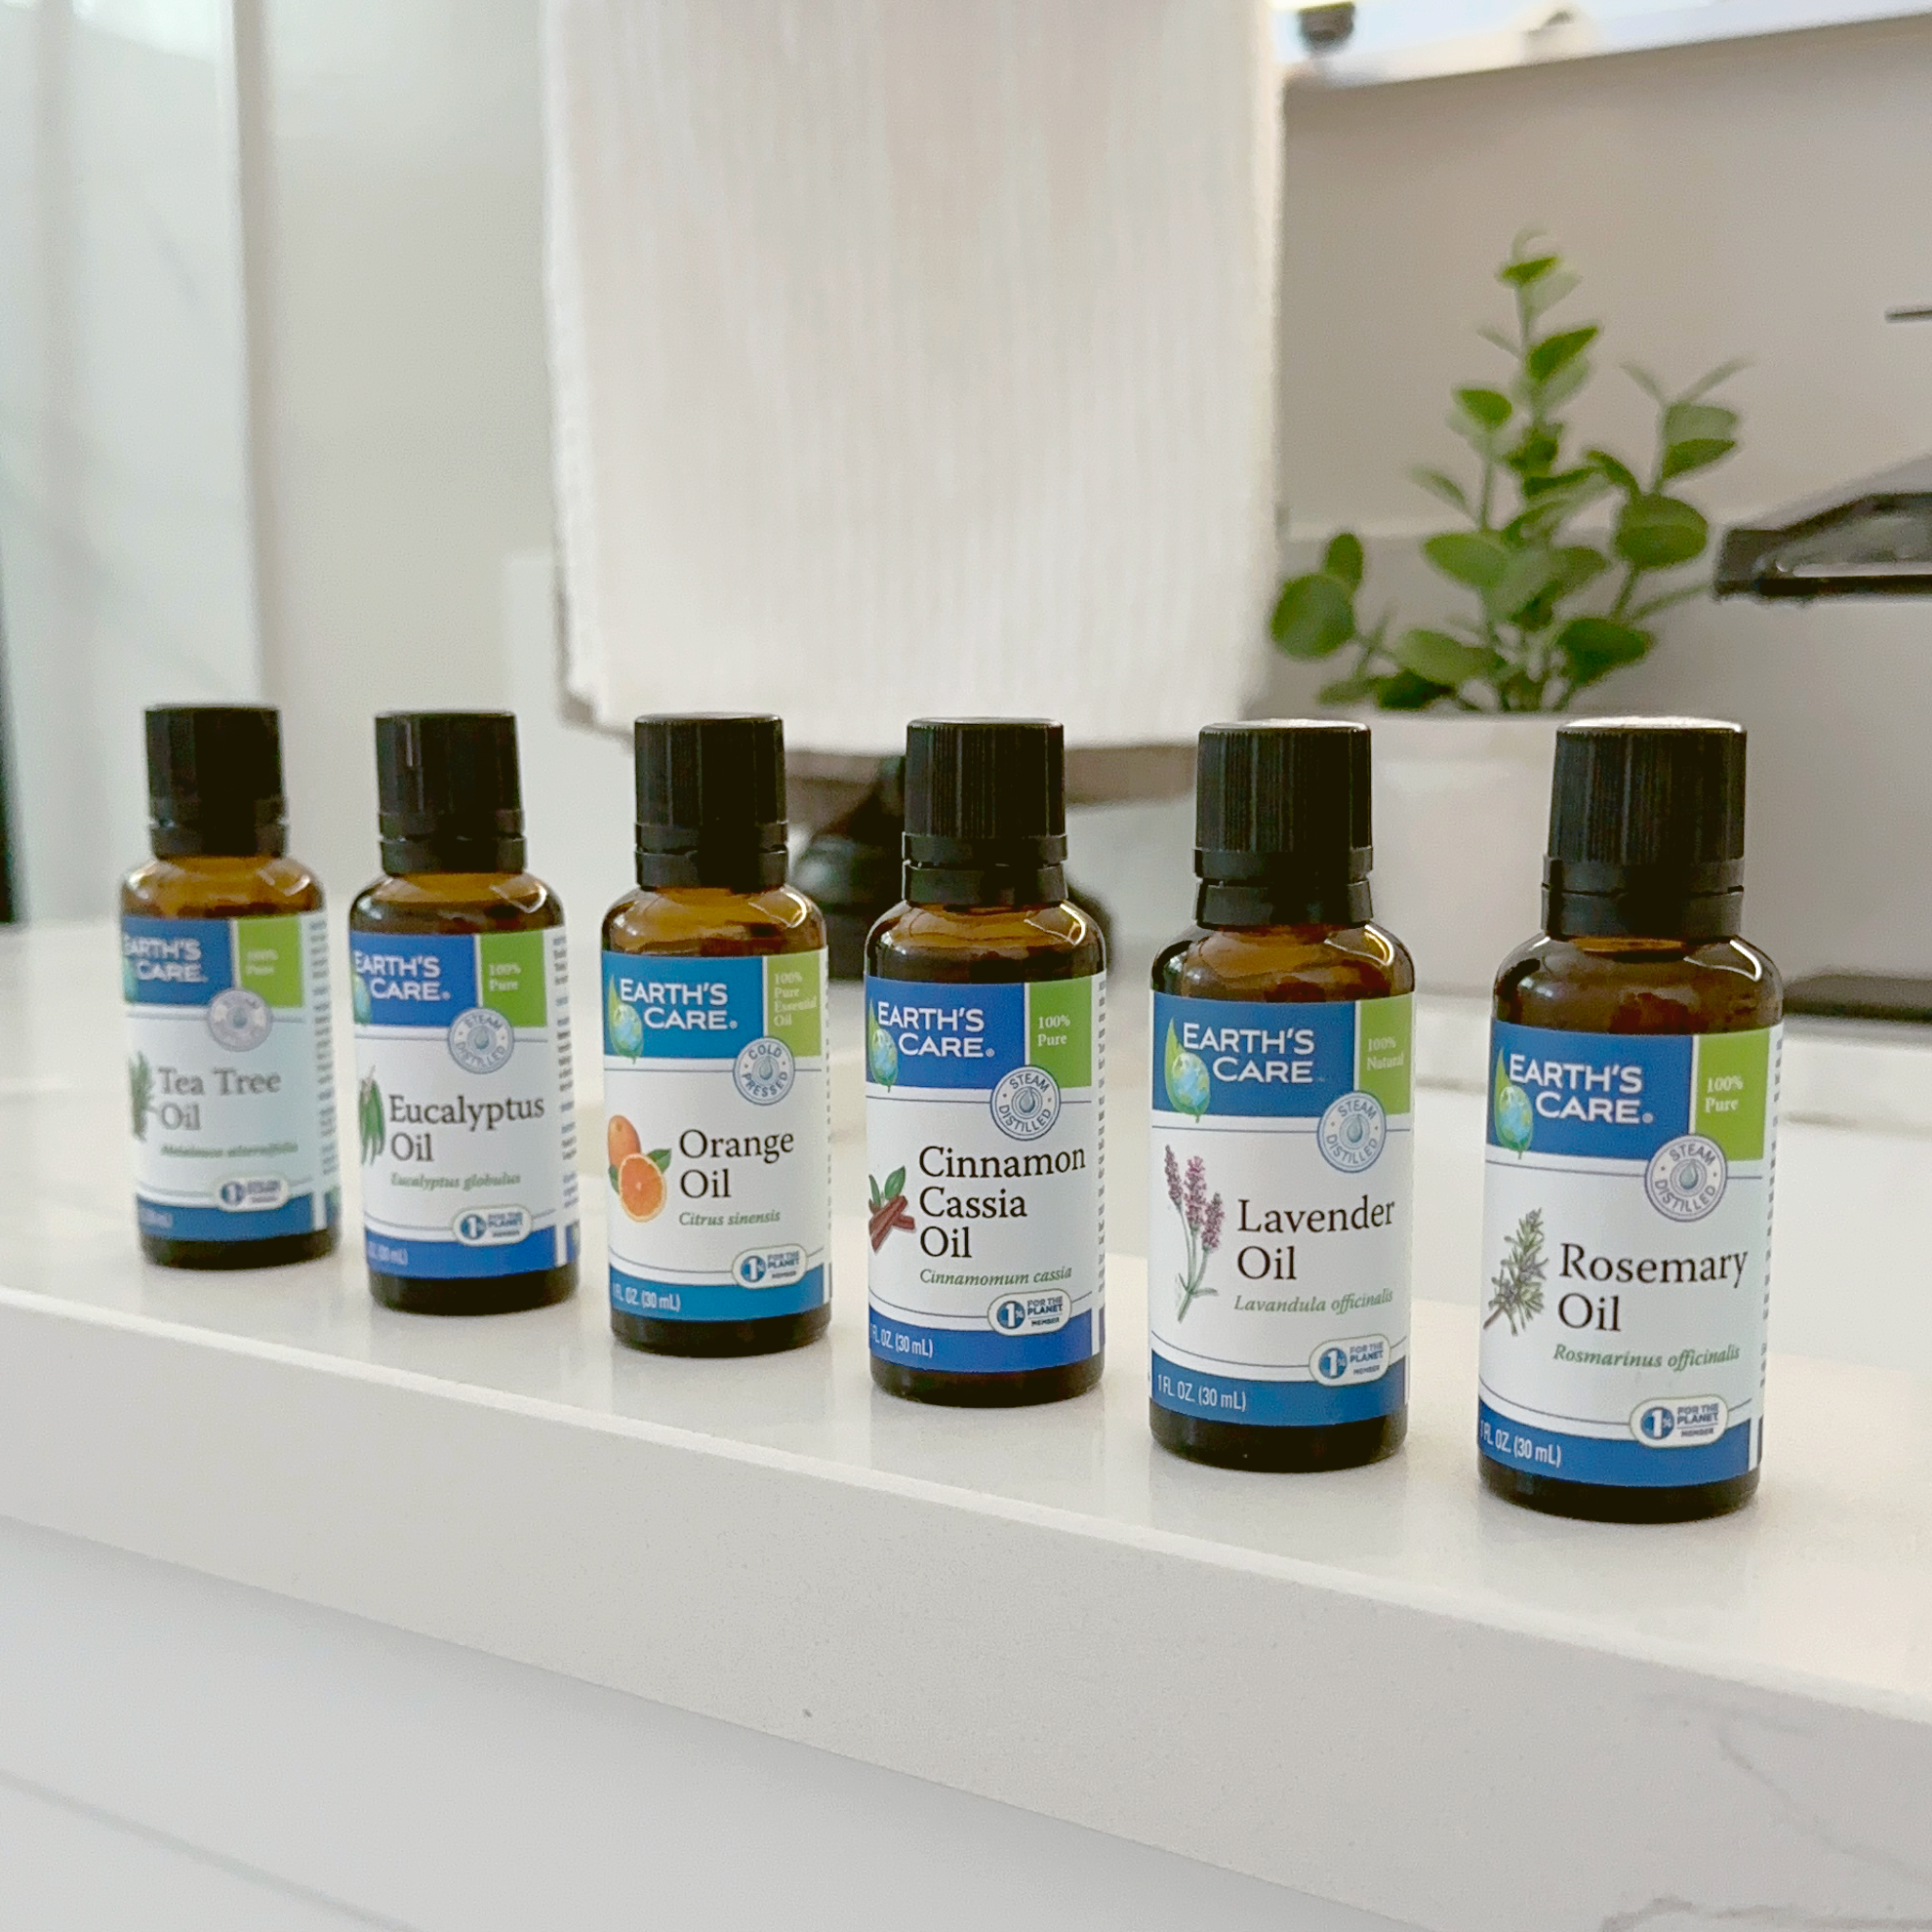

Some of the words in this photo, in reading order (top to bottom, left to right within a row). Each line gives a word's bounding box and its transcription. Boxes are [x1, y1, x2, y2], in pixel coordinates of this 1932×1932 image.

[620, 978, 728, 1006] EARTH'S
[878, 1001, 985, 1032] EARTH'S
[1038, 1015, 1070, 1029] 100%
[748, 1044, 782, 1060] COLD
[1037, 1034, 1067, 1047] Pure
[1183, 1023, 1314, 1055] EARTH'S
[1213, 1056, 1313, 1083] CARE
[1367, 1052, 1404, 1070] Natural
[1509, 1054, 1642, 1094] EARTH'S
[158, 1067, 205, 1096] Tea
[212, 1067, 281, 1096] Tree
[742, 1070, 787, 1098] PRESSED
[1010, 1072, 1050, 1093] STEAM
[1707, 1075, 1744, 1093] 100%
[161, 1103, 201, 1130] Oil
[388, 1095, 544, 1132] Eucalyptus
[999, 1105, 1051, 1133] DISTILLED
[1338, 1101, 1376, 1120] STEAM
[1705, 1098, 1739, 1113] Pure
[391, 1132, 434, 1161] Oil
[679, 1129, 794, 1164] Orange
[1326, 1134, 1378, 1163] DISTILLED
[1669, 1144, 1716, 1166] STEAM
[919, 1146, 1086, 1178] Cinnamon
[680, 1169, 731, 1199] Oil
[1655, 1179, 1716, 1212] DISTILLED
[919, 1187, 1027, 1218] Cassia
[1237, 1194, 1395, 1233] Lavender
[678, 1211, 724, 1226] Citrus
[727, 1209, 781, 1226] sinensis
[920, 1226, 973, 1258] Oil
[920, 1269, 1029, 1286] Cinnamomum
[1033, 1266, 1072, 1283] cassia
[1237, 1245, 1297, 1280] Oil
[1559, 1242, 1748, 1289] Rosemary
[1027, 1305, 1063, 1315] PLANET
[1234, 1295, 1326, 1312] Lavandula
[1330, 1288, 1393, 1315] officinalis
[1558, 1293, 1622, 1332] Oil
[896, 1332, 909, 1352] (30
[911, 1339, 933, 1358] mL)
[1349, 1350, 1384, 1362] PLANET
[1553, 1344, 1663, 1368] Rosmarinus
[1668, 1345, 1740, 1372] officinalis
[1198, 1387, 1218, 1406] (30
[1221, 1390, 1247, 1412] mL)
[1677, 1414, 1718, 1425] PLANET
[1513, 1435, 1532, 1459] (30
[1535, 1444, 1561, 1469] mL)
